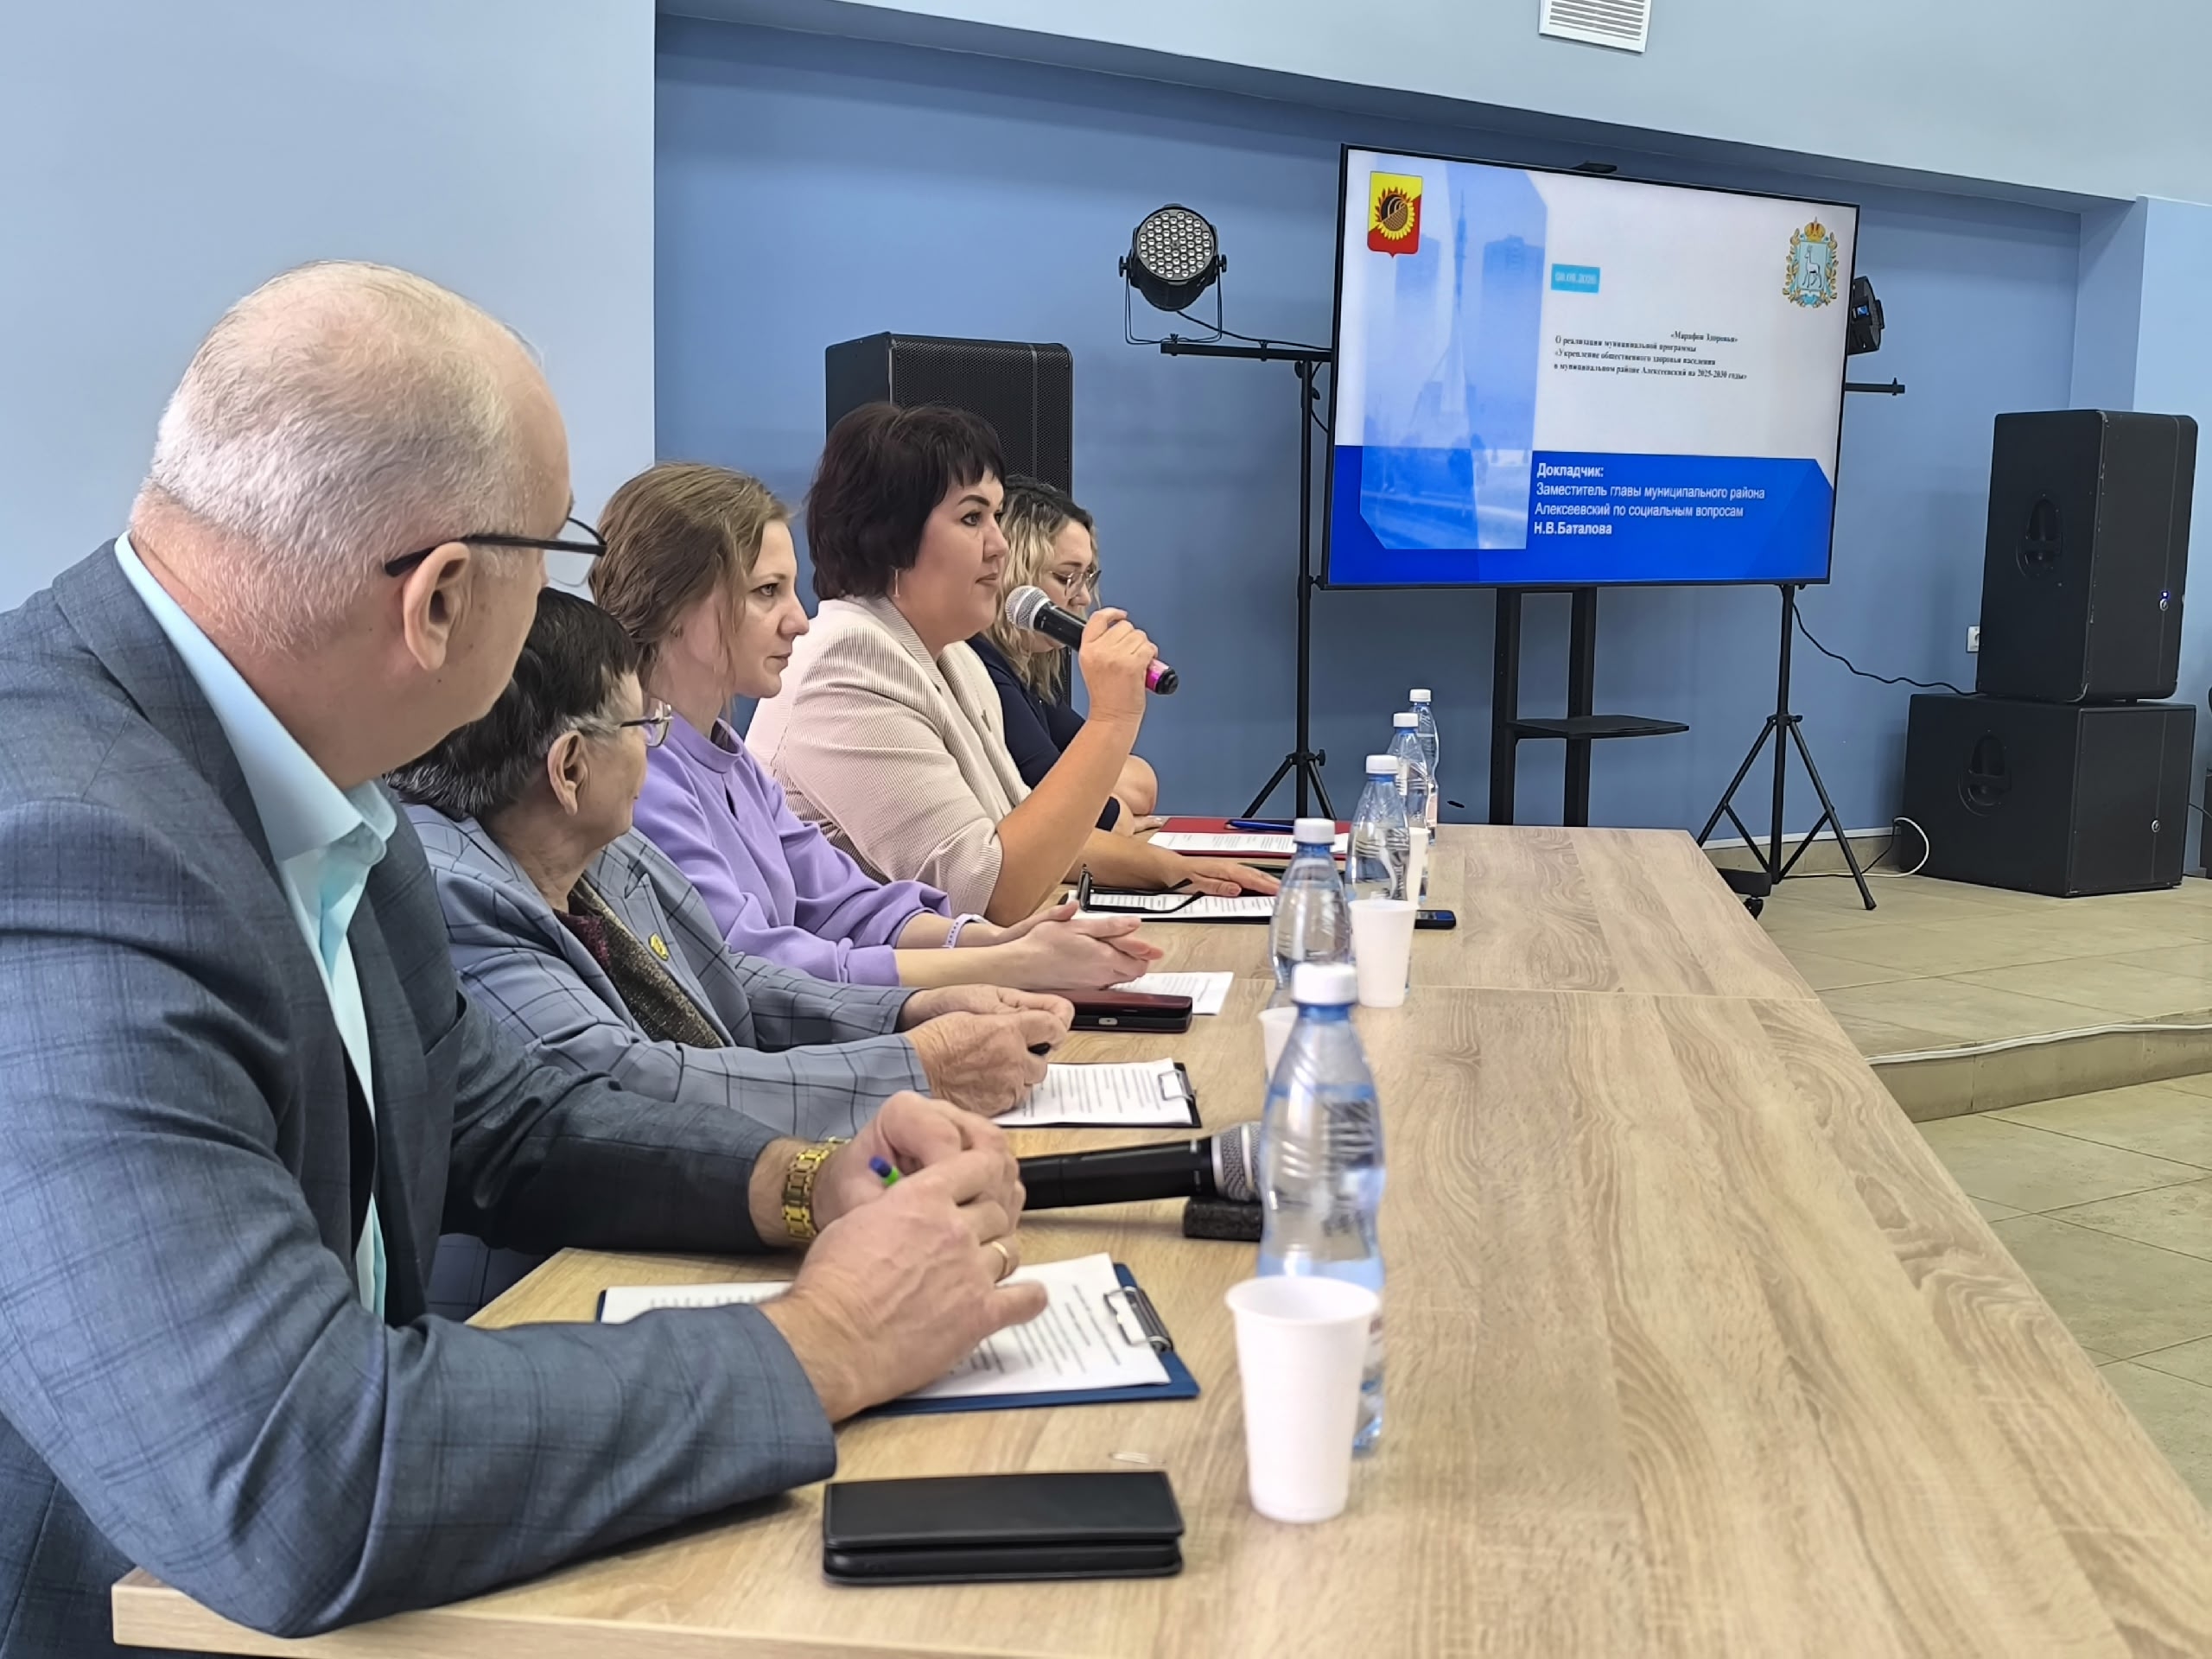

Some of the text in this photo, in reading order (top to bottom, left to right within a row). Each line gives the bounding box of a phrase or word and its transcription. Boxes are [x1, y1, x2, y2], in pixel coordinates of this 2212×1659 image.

[1555, 335, 1696, 353] О реализации муниципальной программы
[1601, 352, 1651, 362] общественного
[1653, 356, 1681, 365] здоровья
[1560, 364, 1615, 372] муниципальном
[1616, 365, 1640, 375] районе
[1641, 366, 1687, 376] Алексеевский
[1697, 369, 1727, 378] 2025-2030
[1536, 463, 1605, 478] Докладчик:
[1536, 482, 1765, 500] Заместитель главы муниципального района
[1535, 502, 1744, 518] Алексеевский по социальным вопросам
[1534, 522, 1612, 535] Н.В.Баталова
